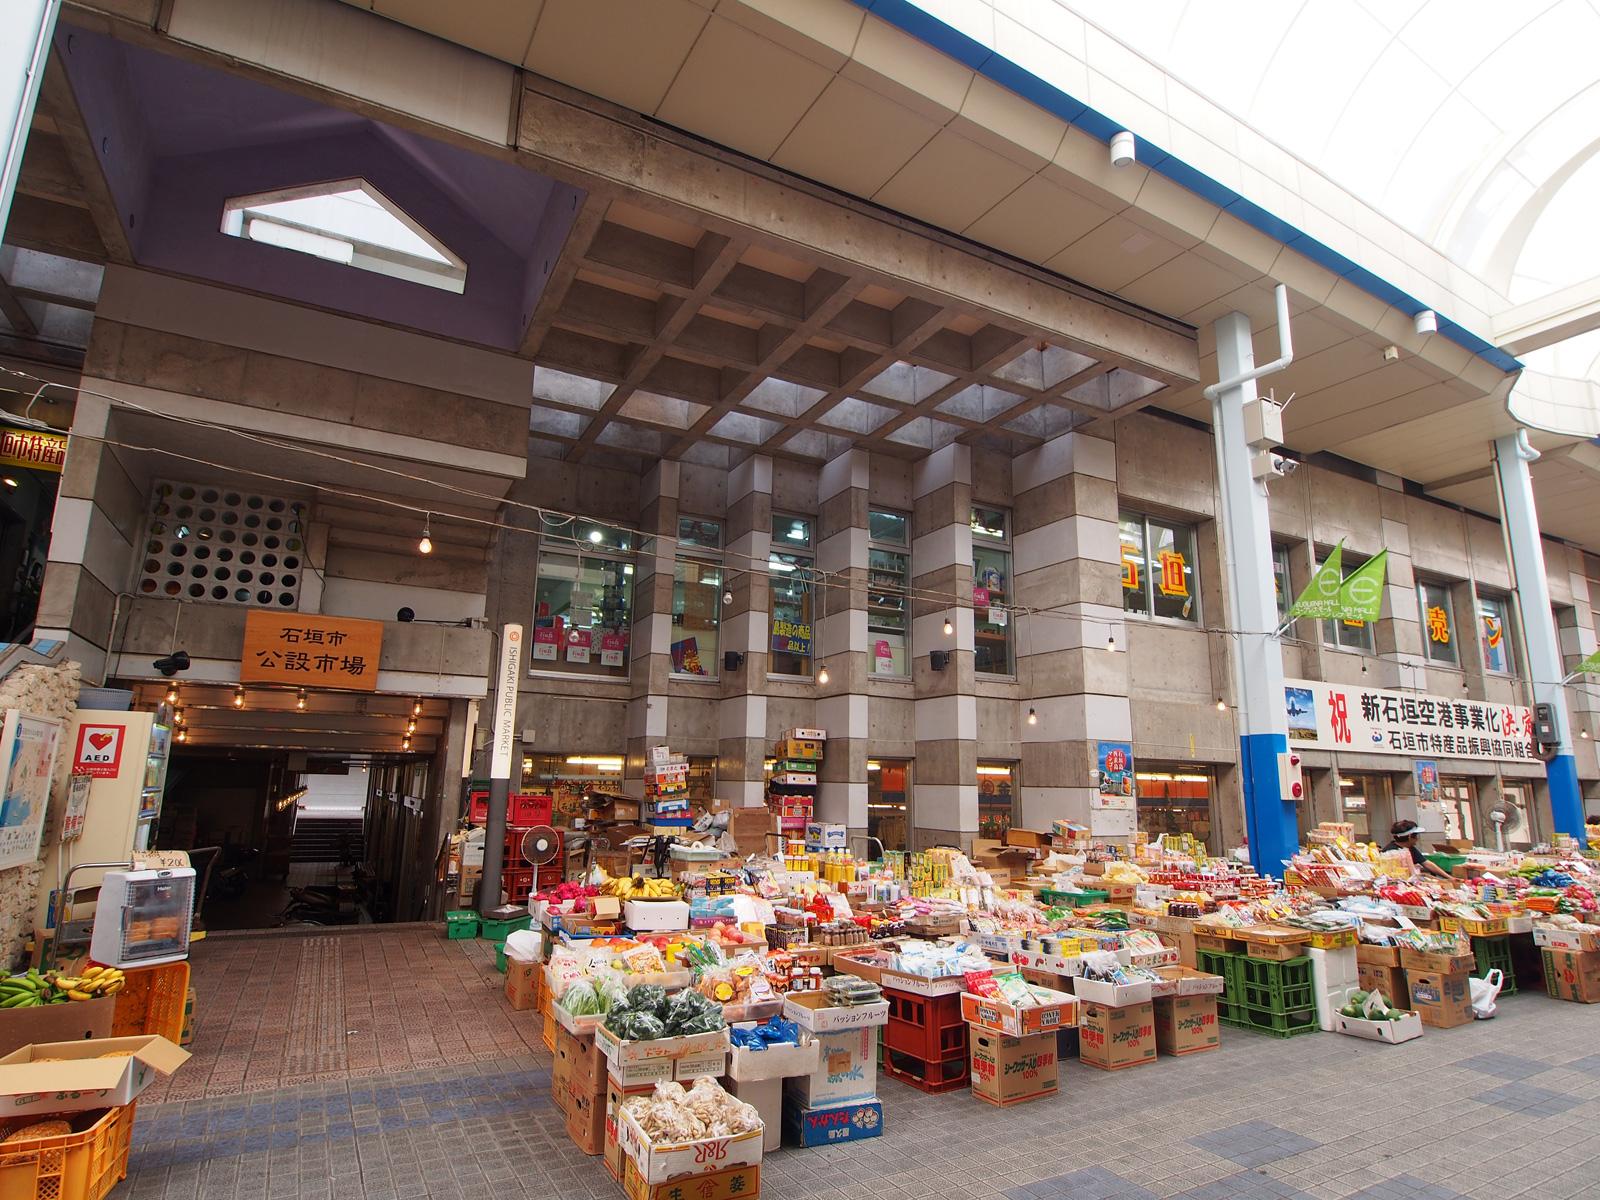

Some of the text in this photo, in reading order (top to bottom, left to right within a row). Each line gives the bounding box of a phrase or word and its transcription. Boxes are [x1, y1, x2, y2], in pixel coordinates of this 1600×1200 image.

[280, 628, 348, 647] 石垣市
[256, 650, 367, 676] 公設市場
[500, 646, 518, 756] ISHIGAKI PUBLIC MARKET
[1328, 690, 1352, 744] 祝
[834, 1010, 887, 1023] パッションフルーツ
[1023, 1070, 1039, 1079] 100%
